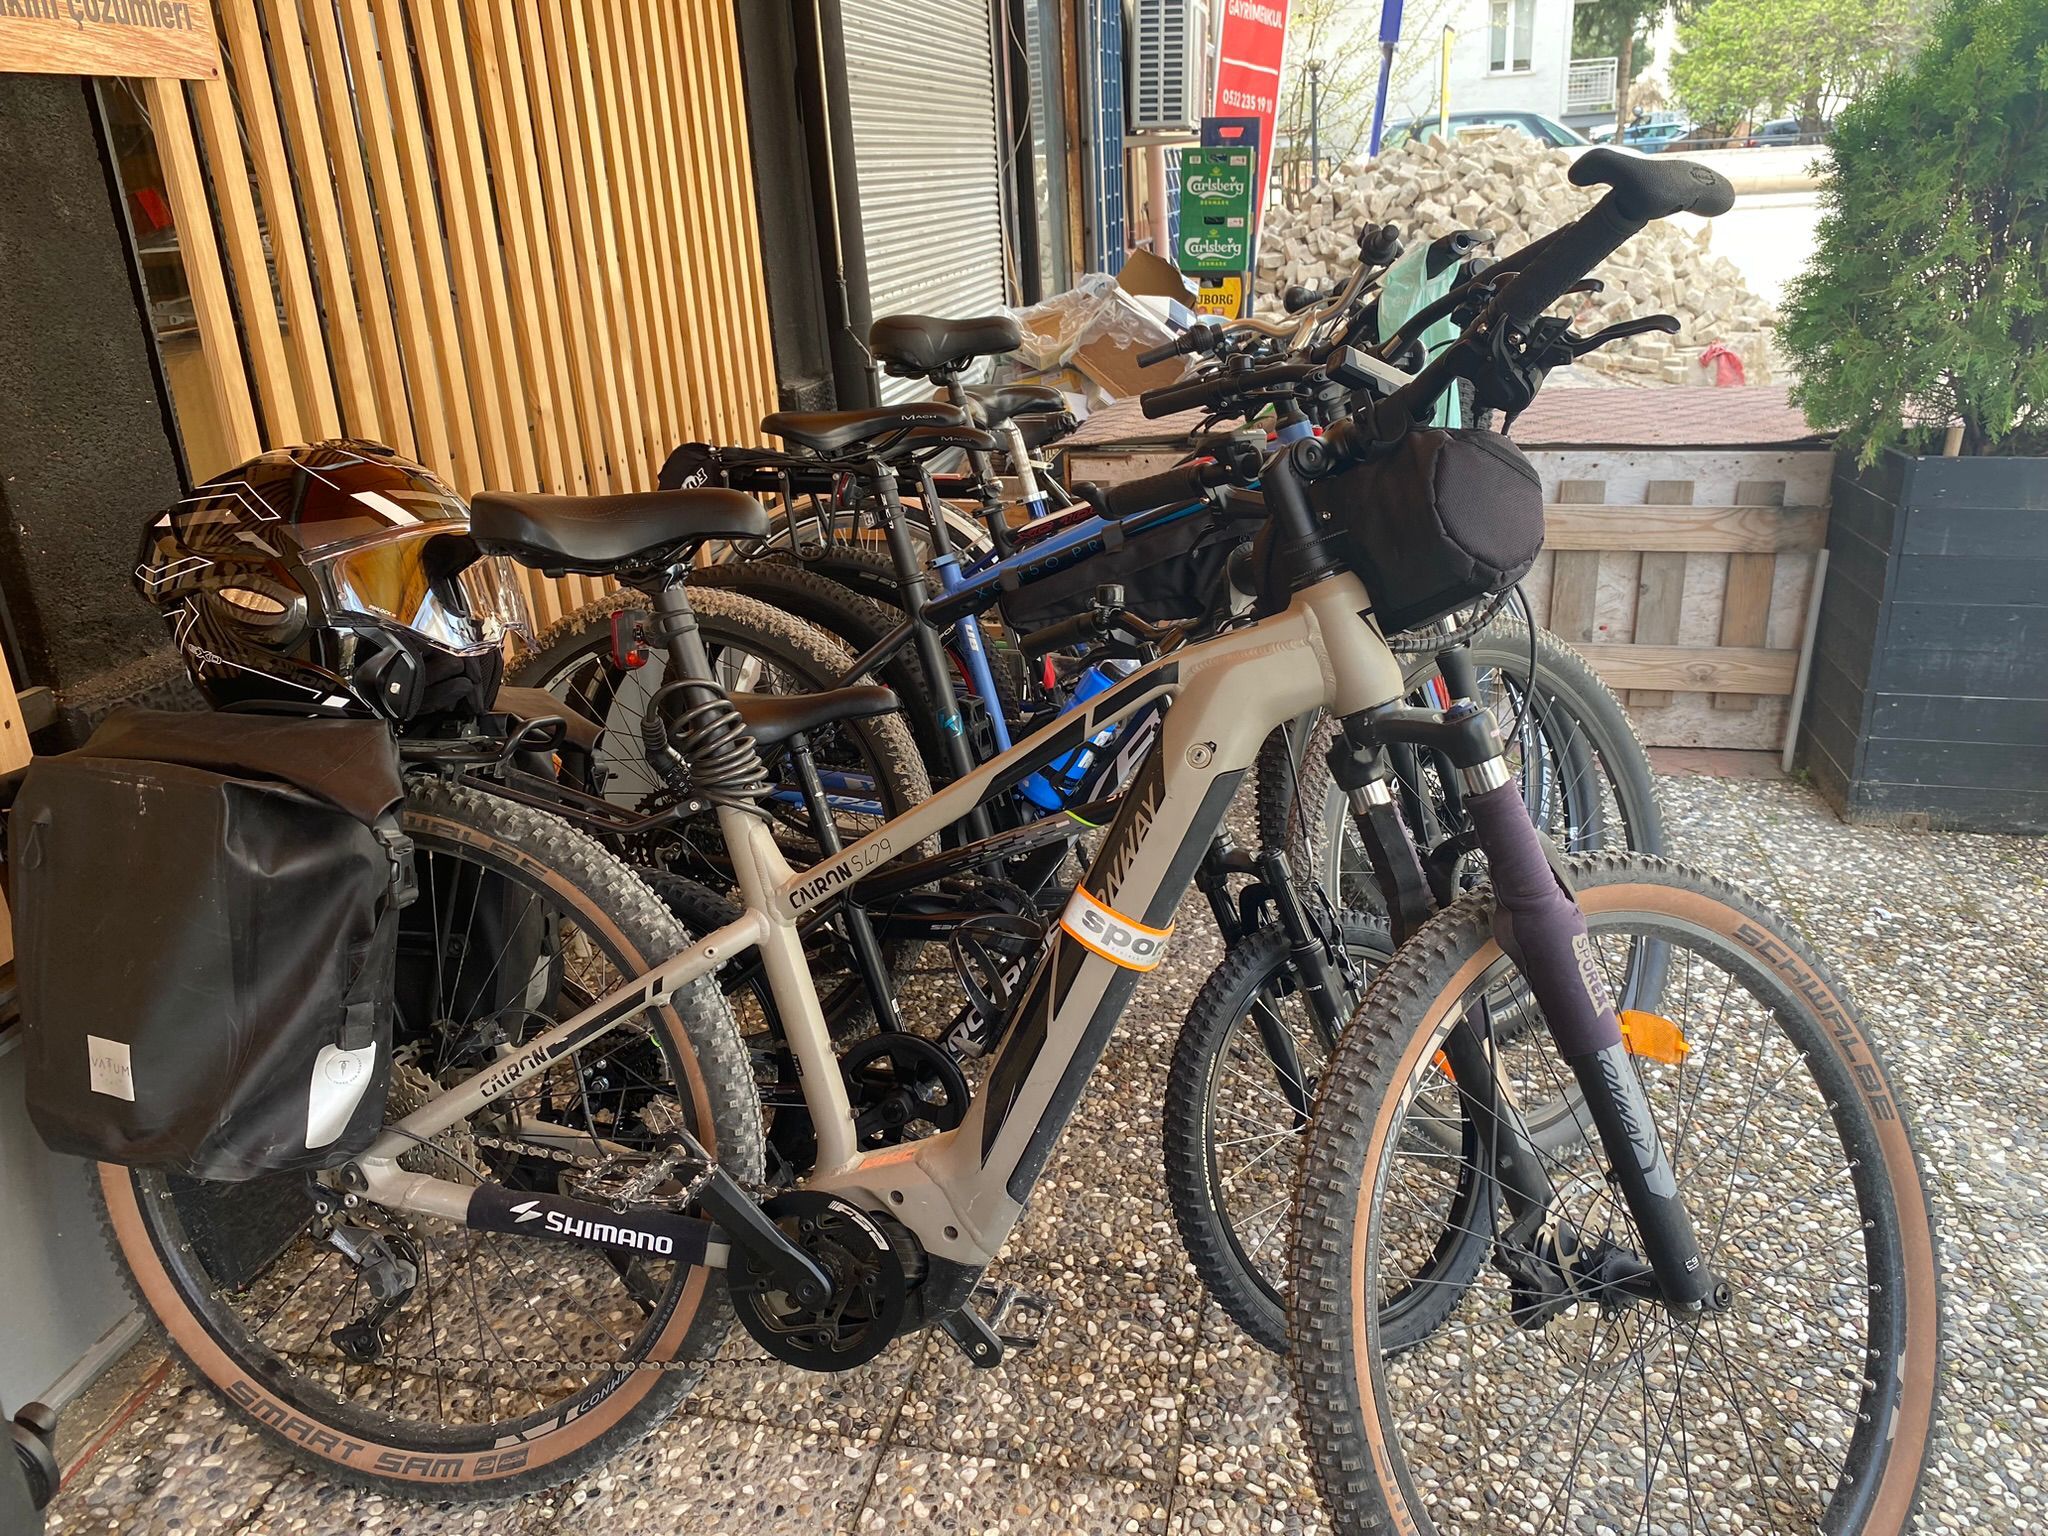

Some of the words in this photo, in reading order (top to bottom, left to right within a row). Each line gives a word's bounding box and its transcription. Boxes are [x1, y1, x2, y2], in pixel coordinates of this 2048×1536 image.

[1186, 175, 1245, 197] Carlsberg
[1184, 237, 1242, 258] Carlsberg
[1732, 923, 1896, 1121] SCHWALBE
[545, 1210, 673, 1255] SHIMANO
[226, 1379, 365, 1461] SMART
[373, 1451, 464, 1478] SAM
